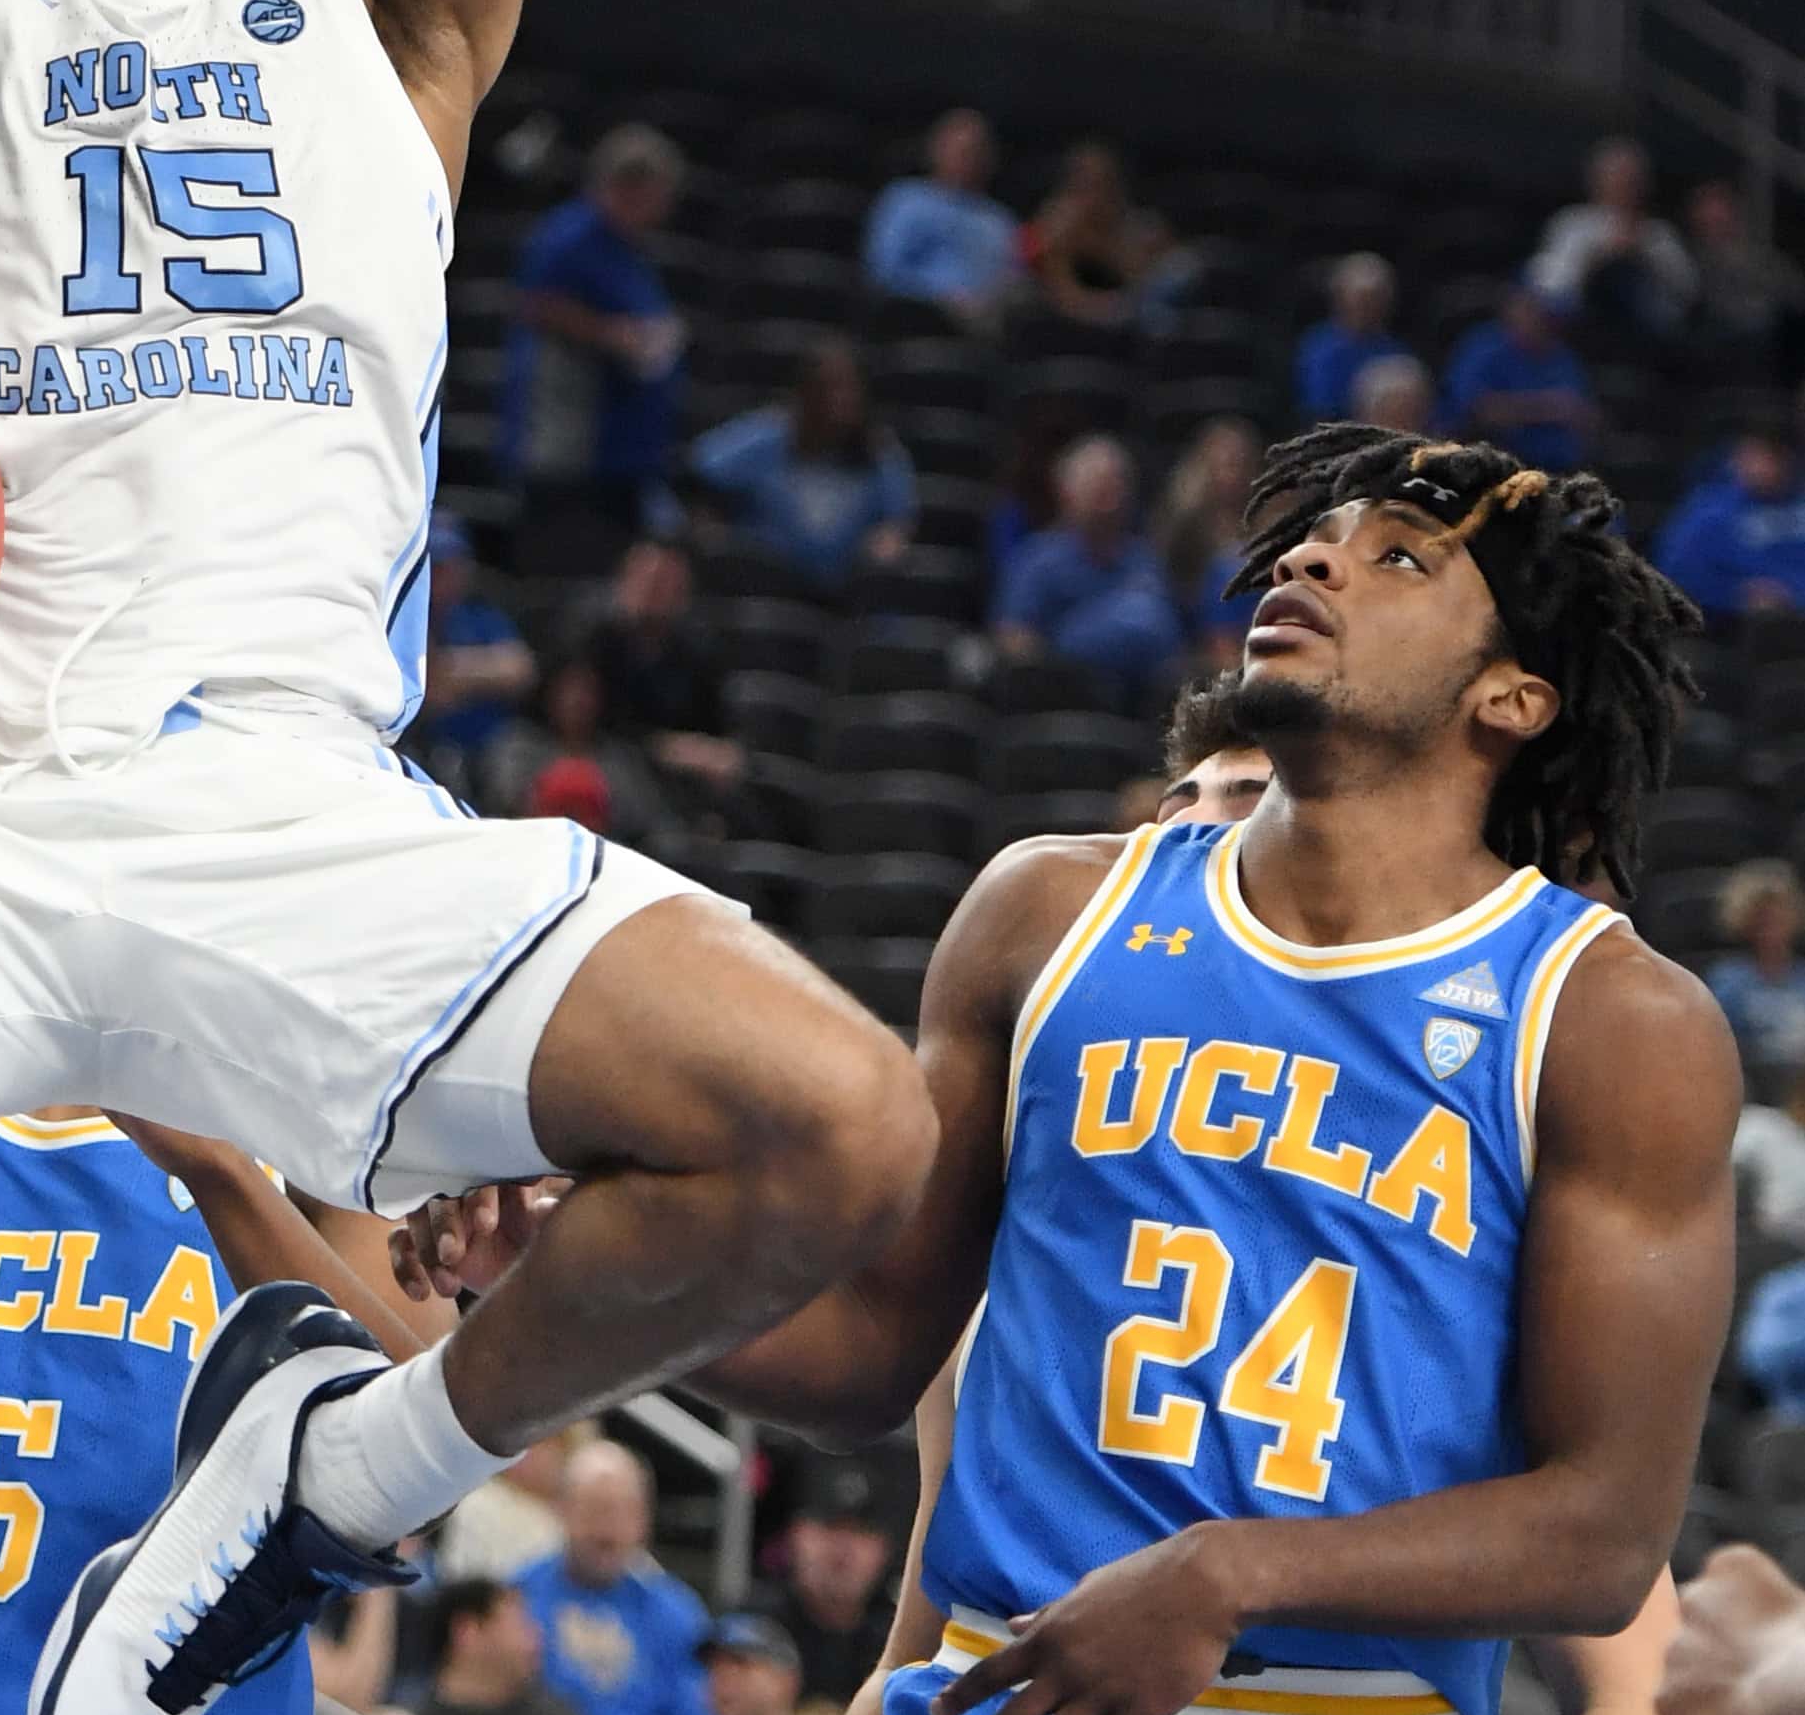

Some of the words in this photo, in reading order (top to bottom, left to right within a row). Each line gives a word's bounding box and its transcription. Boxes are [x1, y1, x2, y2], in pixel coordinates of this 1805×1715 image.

[252, 5, 298, 23] ACC
[62, 145, 304, 316] 15
[1435, 982, 1500, 1009] JRW
[1071, 1037, 1478, 1258] UCLA
[1098, 1220, 1358, 1503] 24
